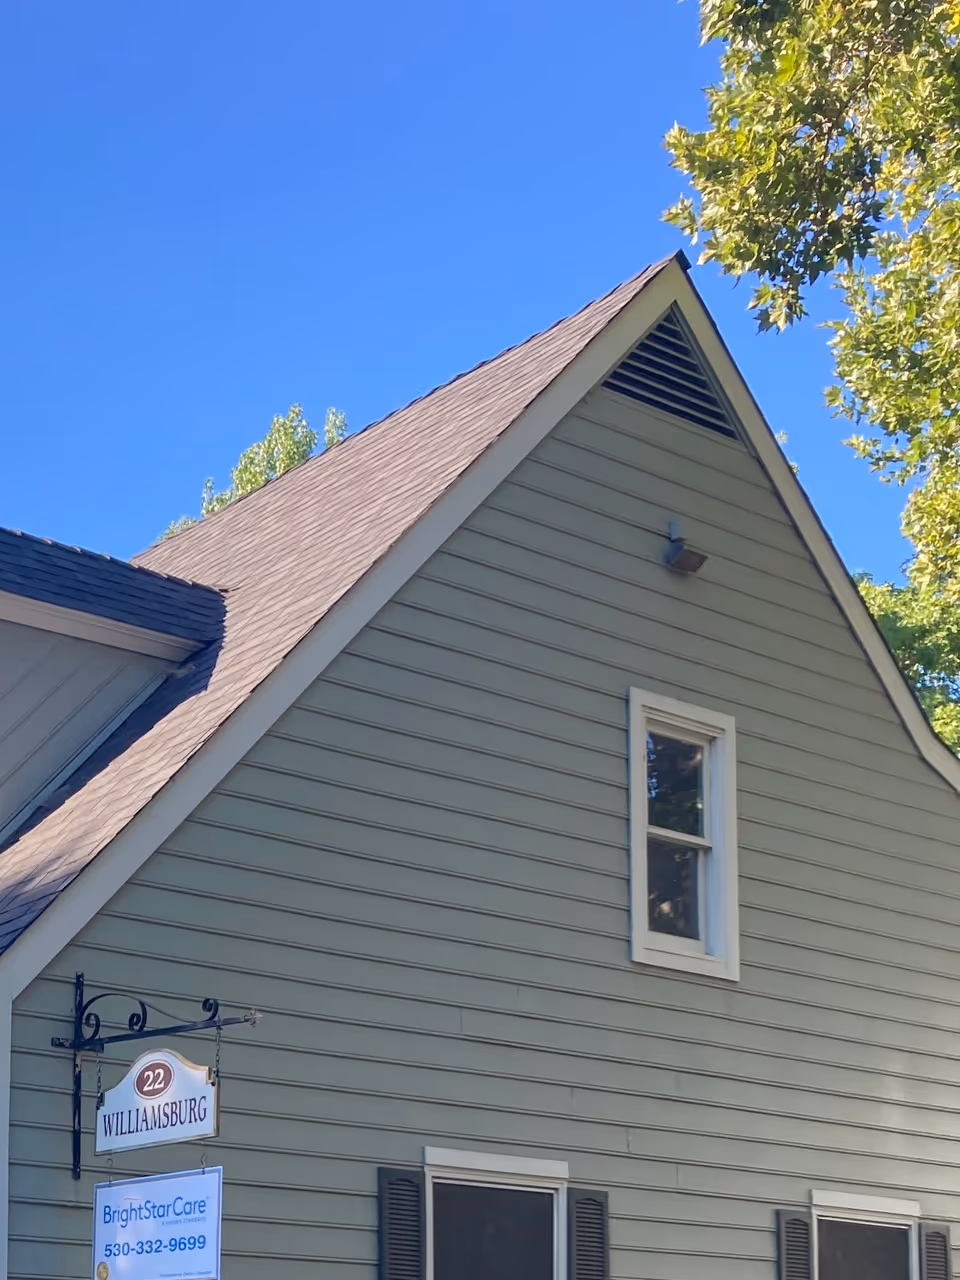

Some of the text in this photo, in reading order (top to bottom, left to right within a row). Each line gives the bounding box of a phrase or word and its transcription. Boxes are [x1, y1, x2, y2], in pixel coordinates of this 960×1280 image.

[142, 1068, 165, 1092] 22
[103, 1095, 207, 1137] WILLIAMSBURG
[104, 1234, 207, 1258] 530-332-9699
